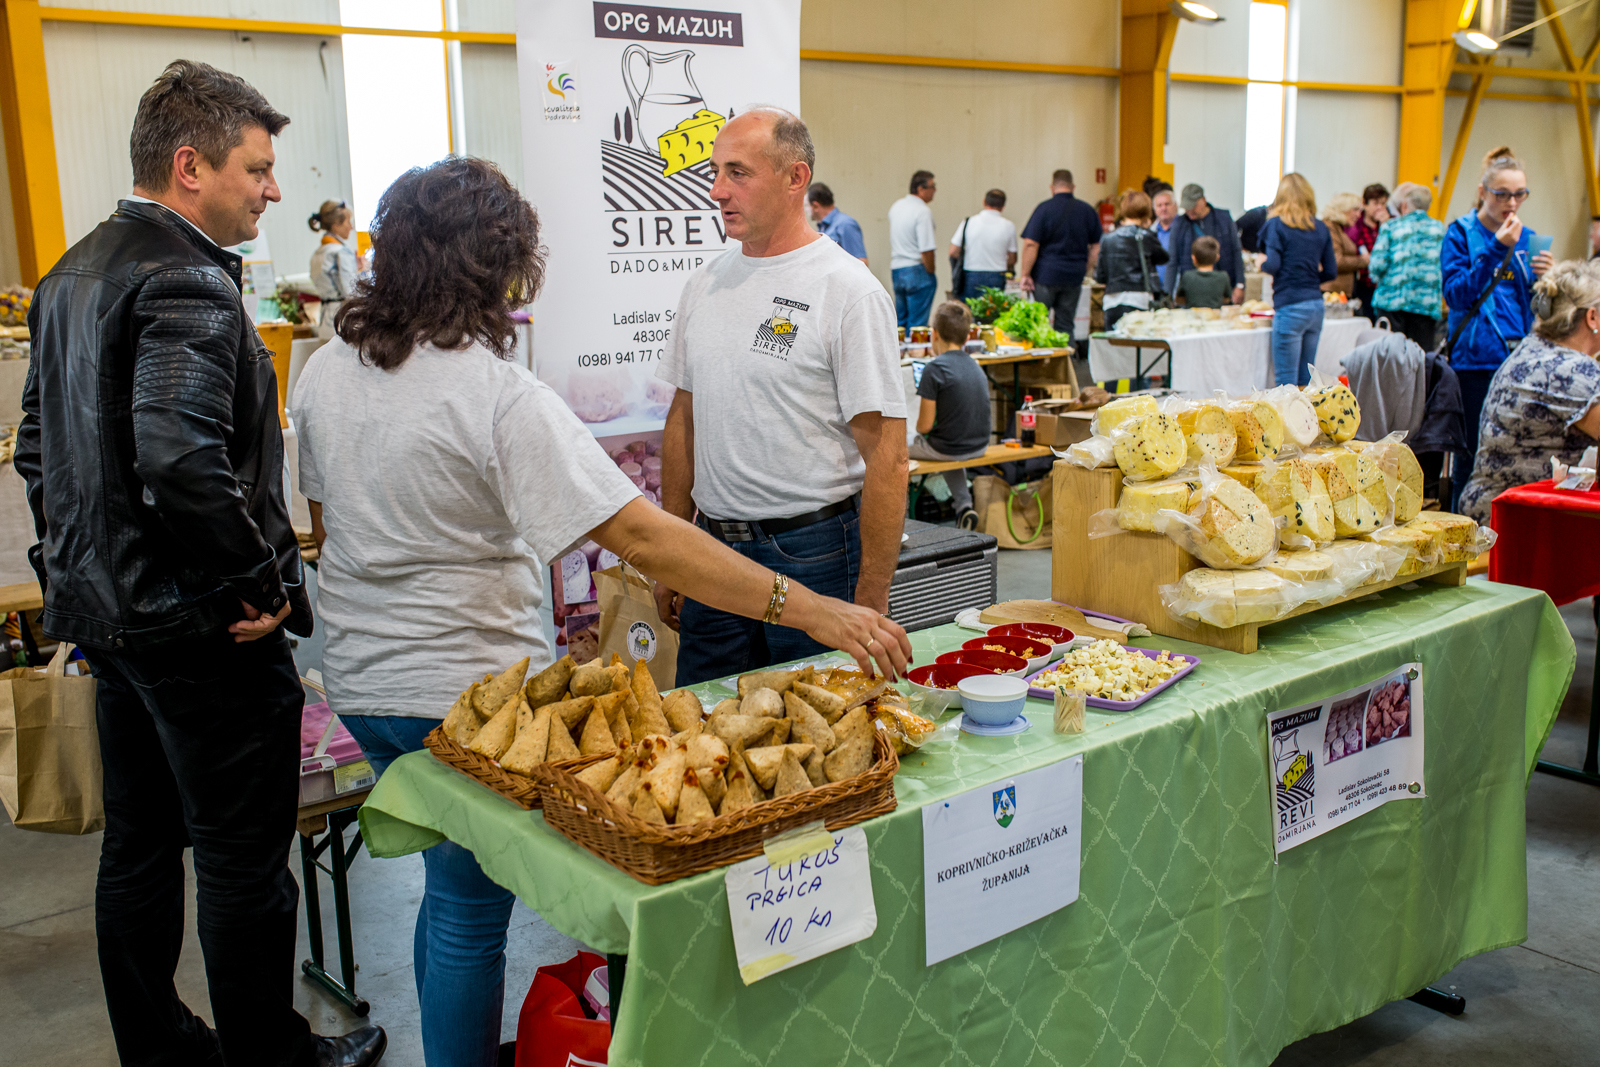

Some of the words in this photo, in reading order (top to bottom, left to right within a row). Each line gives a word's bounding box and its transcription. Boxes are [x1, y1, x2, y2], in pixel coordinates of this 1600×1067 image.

[603, 10, 650, 34] OPG
[656, 15, 734, 39] MAZUH
[774, 297, 787, 305] OPG
[787, 300, 808, 311] MAZUH
[613, 310, 661, 326] Ladislav
[577, 352, 611, 368] (098)
[615, 351, 635, 365] 941
[639, 349, 653, 363] 77
[752, 339, 790, 356] SIREVI
[1285, 710, 1318, 728] MAZUH
[1338, 781, 1357, 796] Ladislav
[1383, 768, 1390, 777] 58
[1360, 780, 1383, 795] Sokolovac
[1388, 784, 1397, 792] 48
[1398, 782, 1407, 791] 89
[753, 835, 844, 890] TUROŠ
[936, 824, 1069, 884] KOPRIVNIČKO-KRIŽEVAČKA
[981, 863, 1031, 892] ŽUPANIJA
[745, 875, 822, 912] PRGICA
[764, 916, 793, 946] 10
